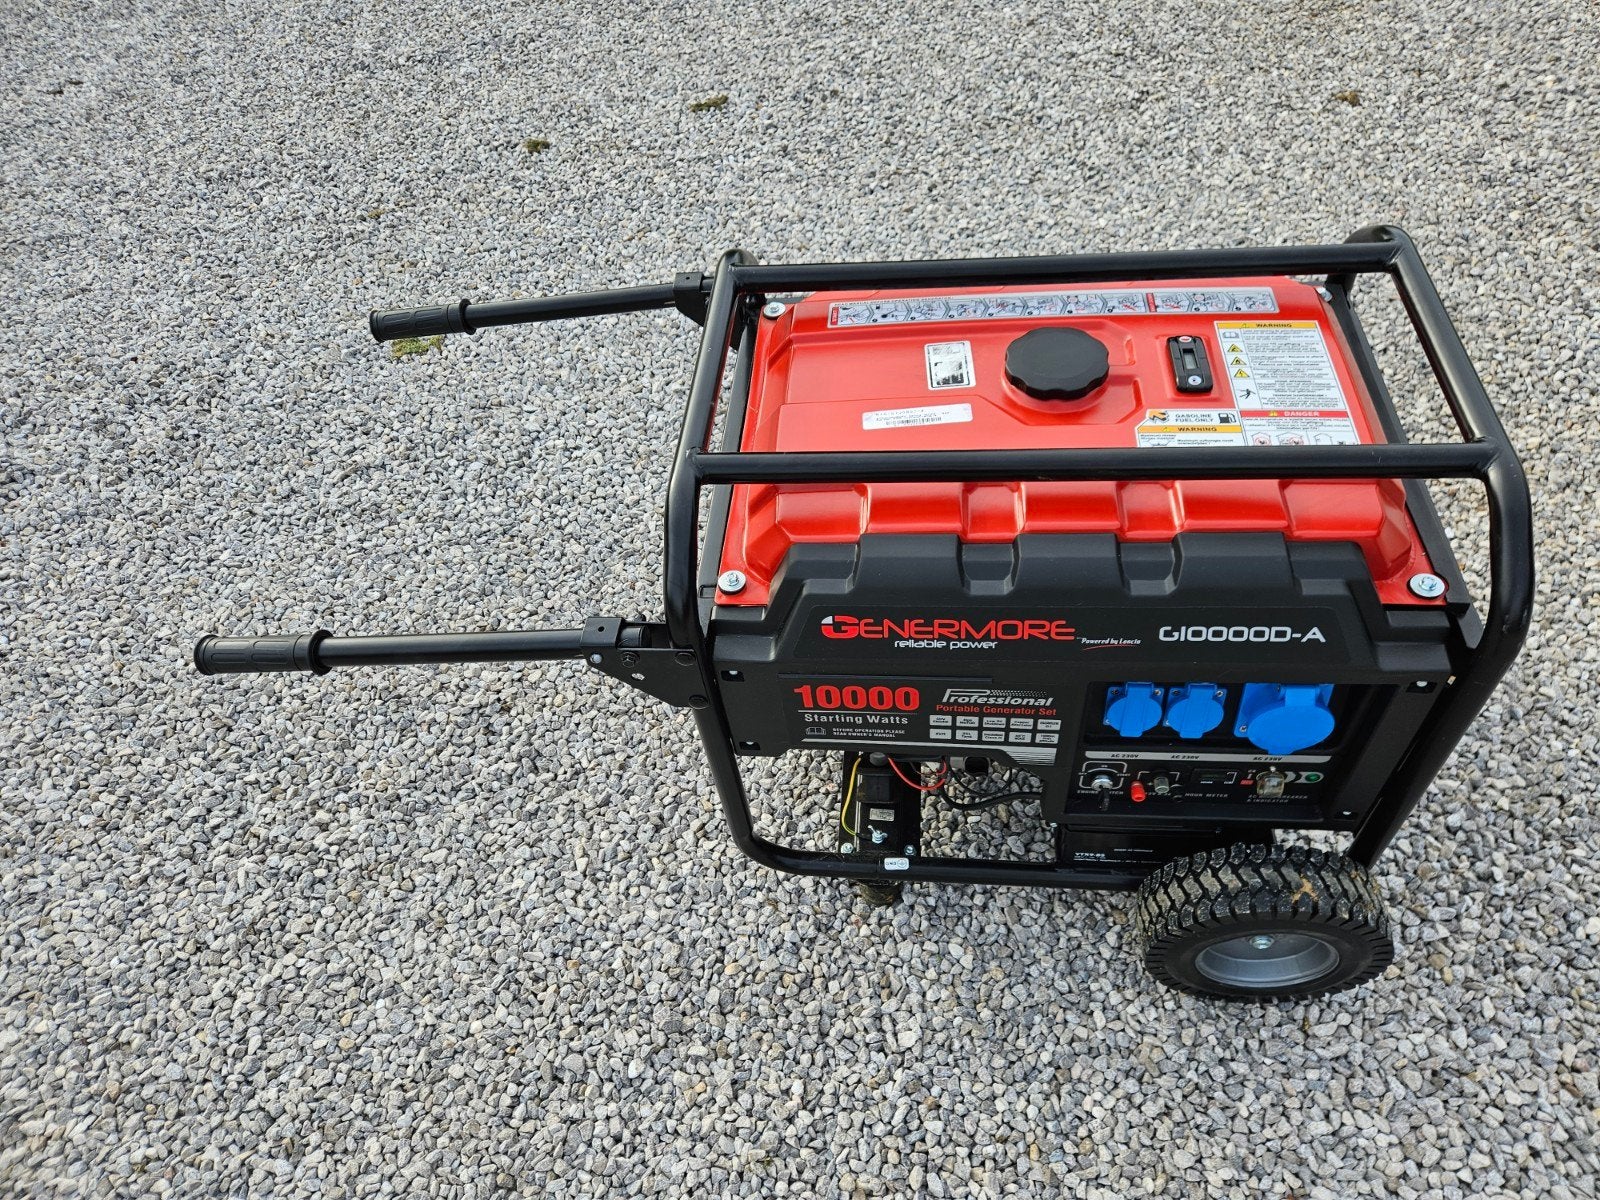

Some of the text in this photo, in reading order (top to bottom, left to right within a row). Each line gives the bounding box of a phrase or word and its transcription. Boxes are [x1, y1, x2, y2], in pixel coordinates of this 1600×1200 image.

[821, 615, 1076, 640] GENERMORE
[894, 639, 998, 650] reliable power
[793, 685, 920, 711] 10000
[941, 688, 1054, 706] Professional
[936, 704, 980, 713] Portable
[983, 706, 1036, 714] Generator
[804, 714, 908, 724] Starting Watts
